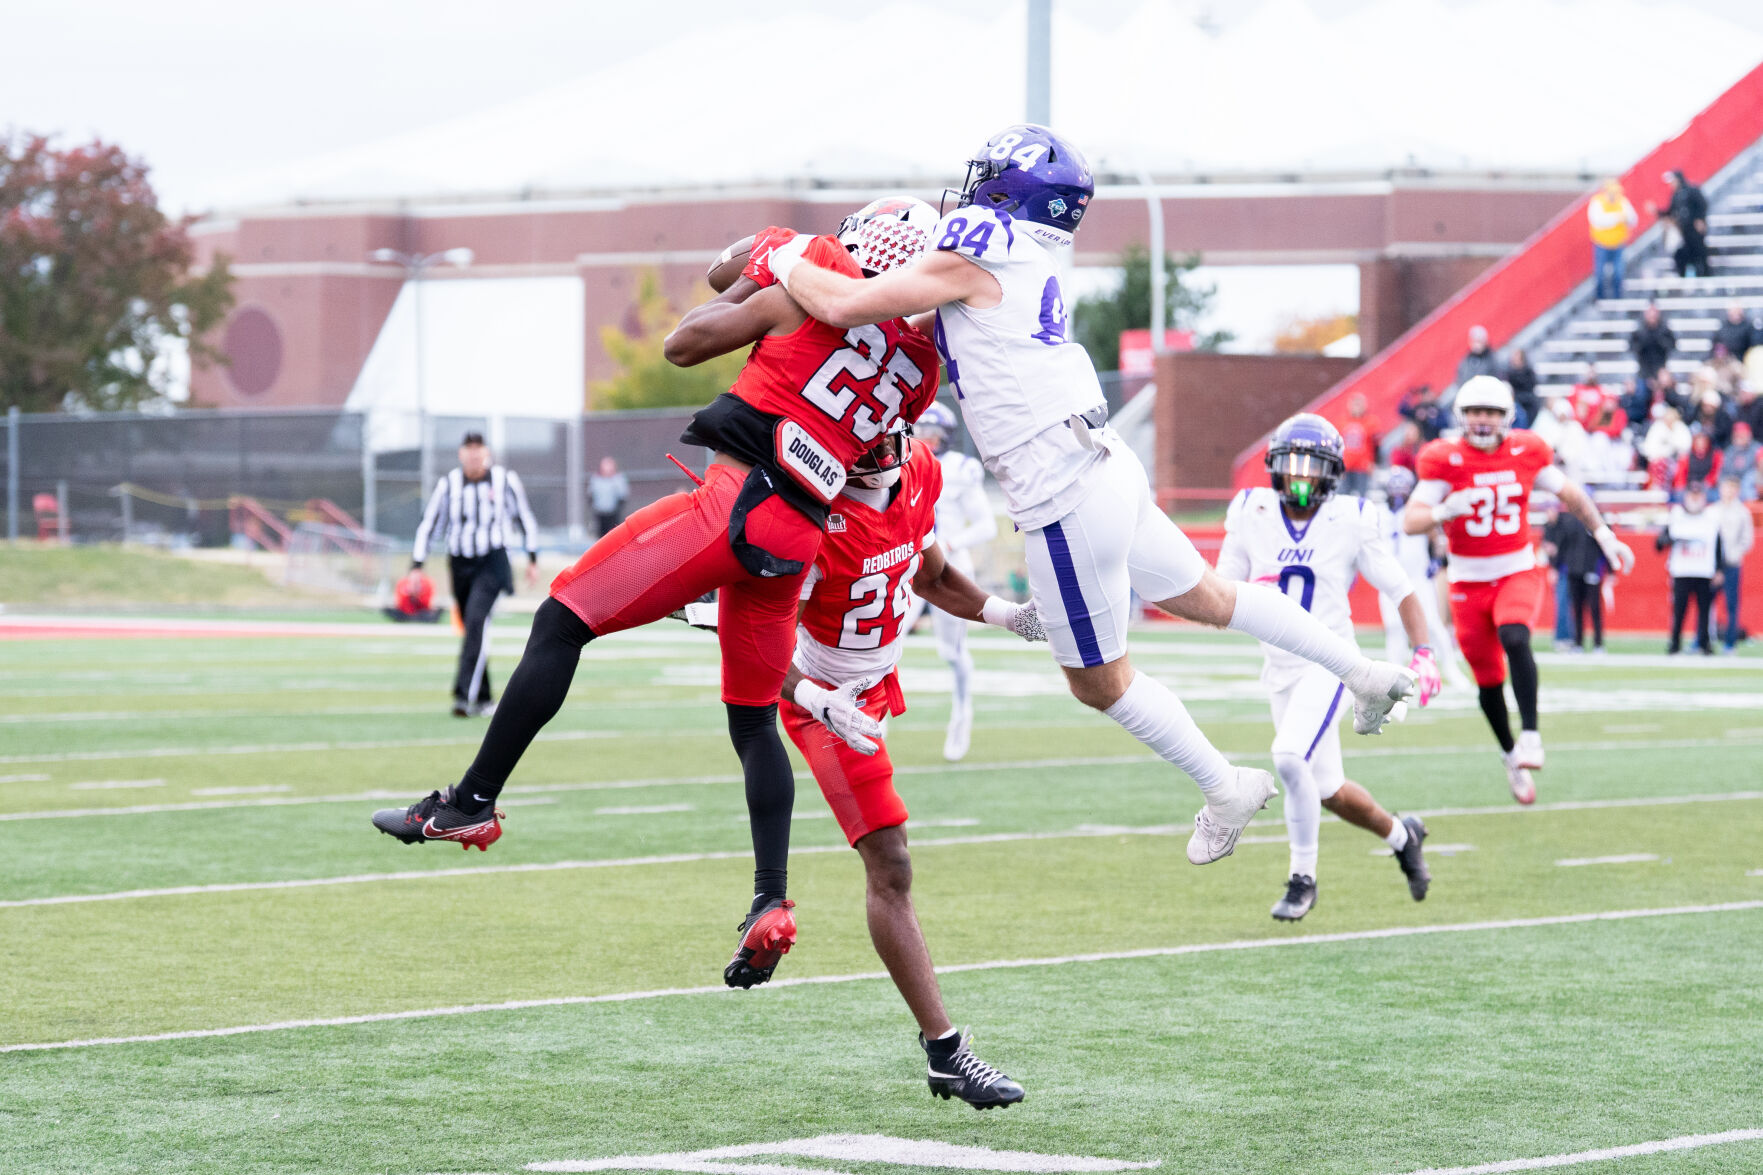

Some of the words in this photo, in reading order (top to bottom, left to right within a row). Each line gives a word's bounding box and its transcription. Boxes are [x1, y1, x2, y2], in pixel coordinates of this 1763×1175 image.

[989, 133, 1048, 173] 84
[937, 217, 997, 258] 84
[1034, 228, 1061, 242] EVER
[800, 323, 923, 443] 25
[788, 436, 838, 487] DOUGLAS
[1464, 482, 1523, 538] 35
[862, 541, 914, 575] REDBIRDS
[1278, 548, 1315, 562] UNI
[837, 551, 920, 651] 24
